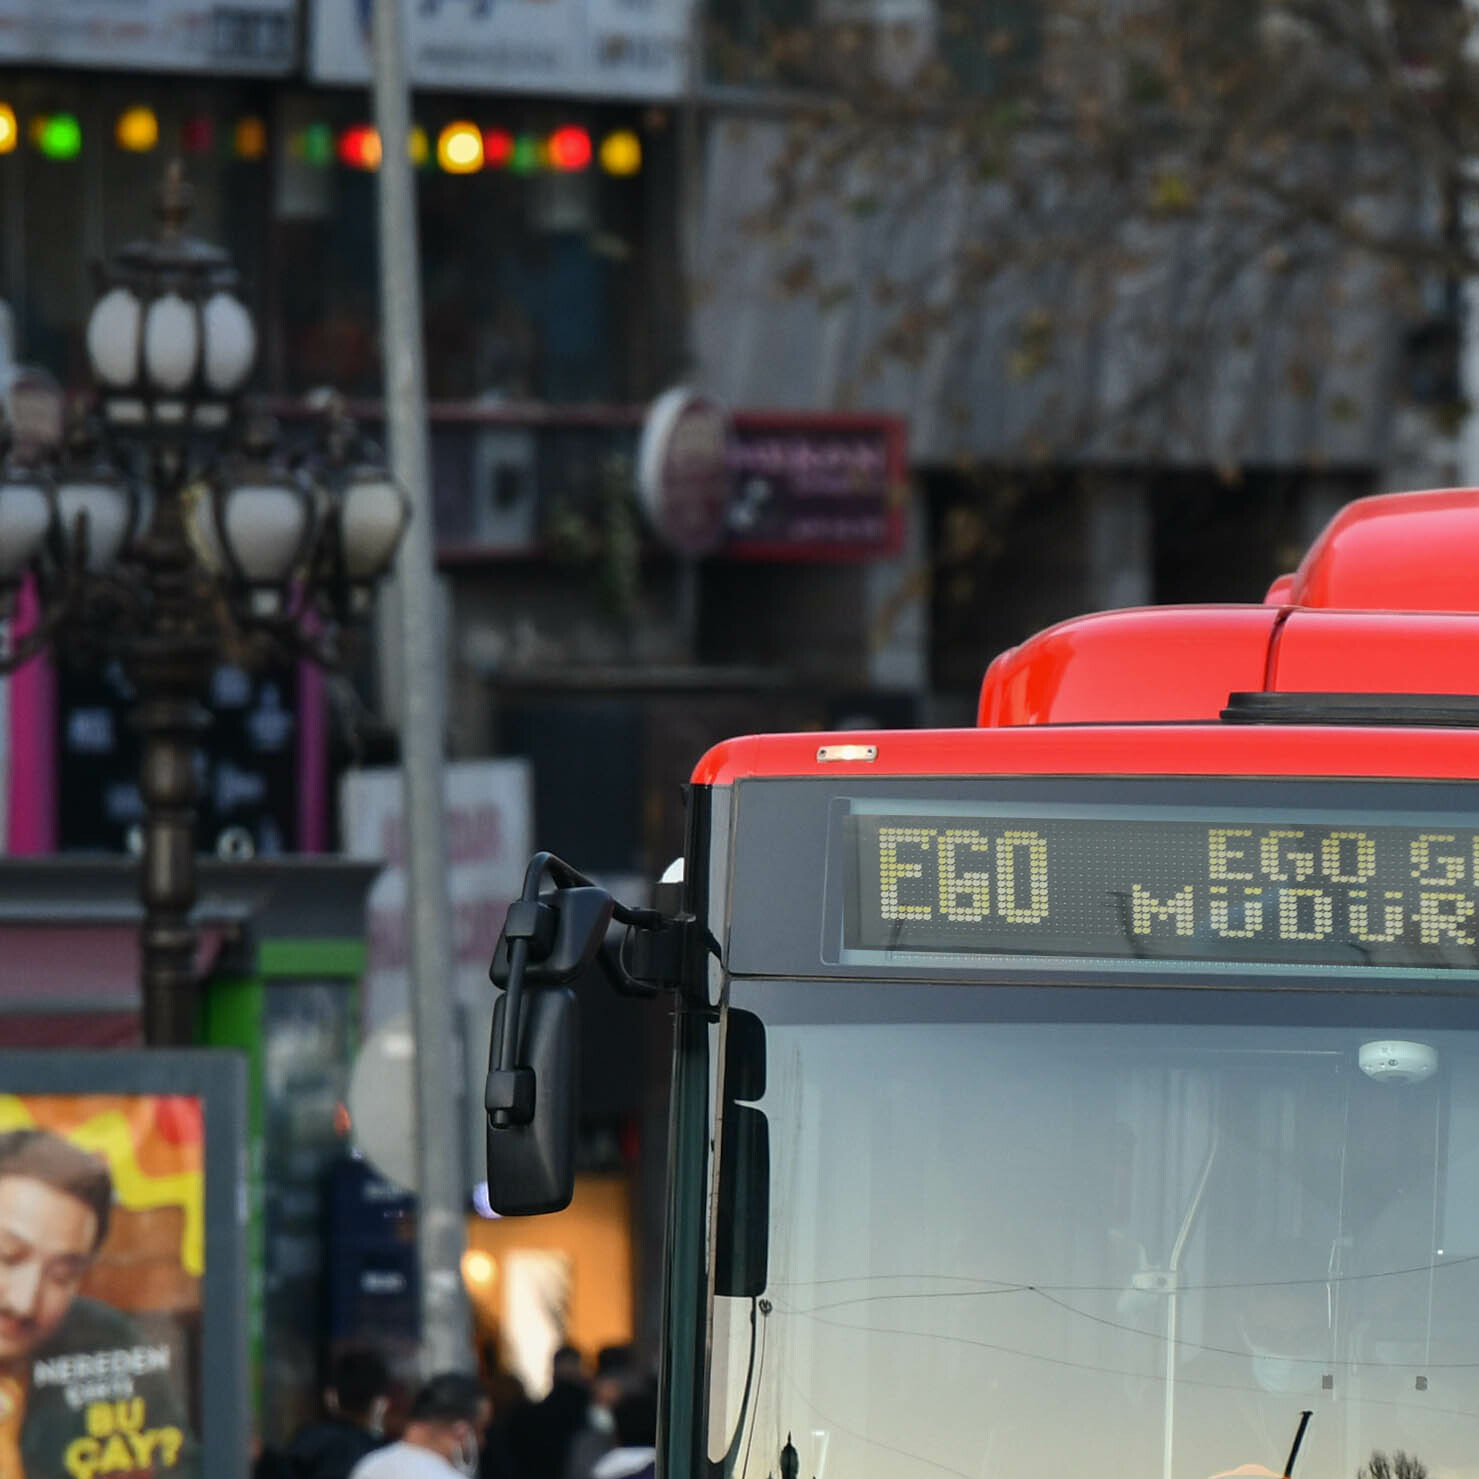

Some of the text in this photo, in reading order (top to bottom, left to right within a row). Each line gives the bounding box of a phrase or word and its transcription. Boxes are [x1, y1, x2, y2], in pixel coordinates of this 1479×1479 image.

[879, 828, 1049, 924] EGO
[1209, 828, 1376, 884] EGO
[86, 1396, 146, 1438] BU
